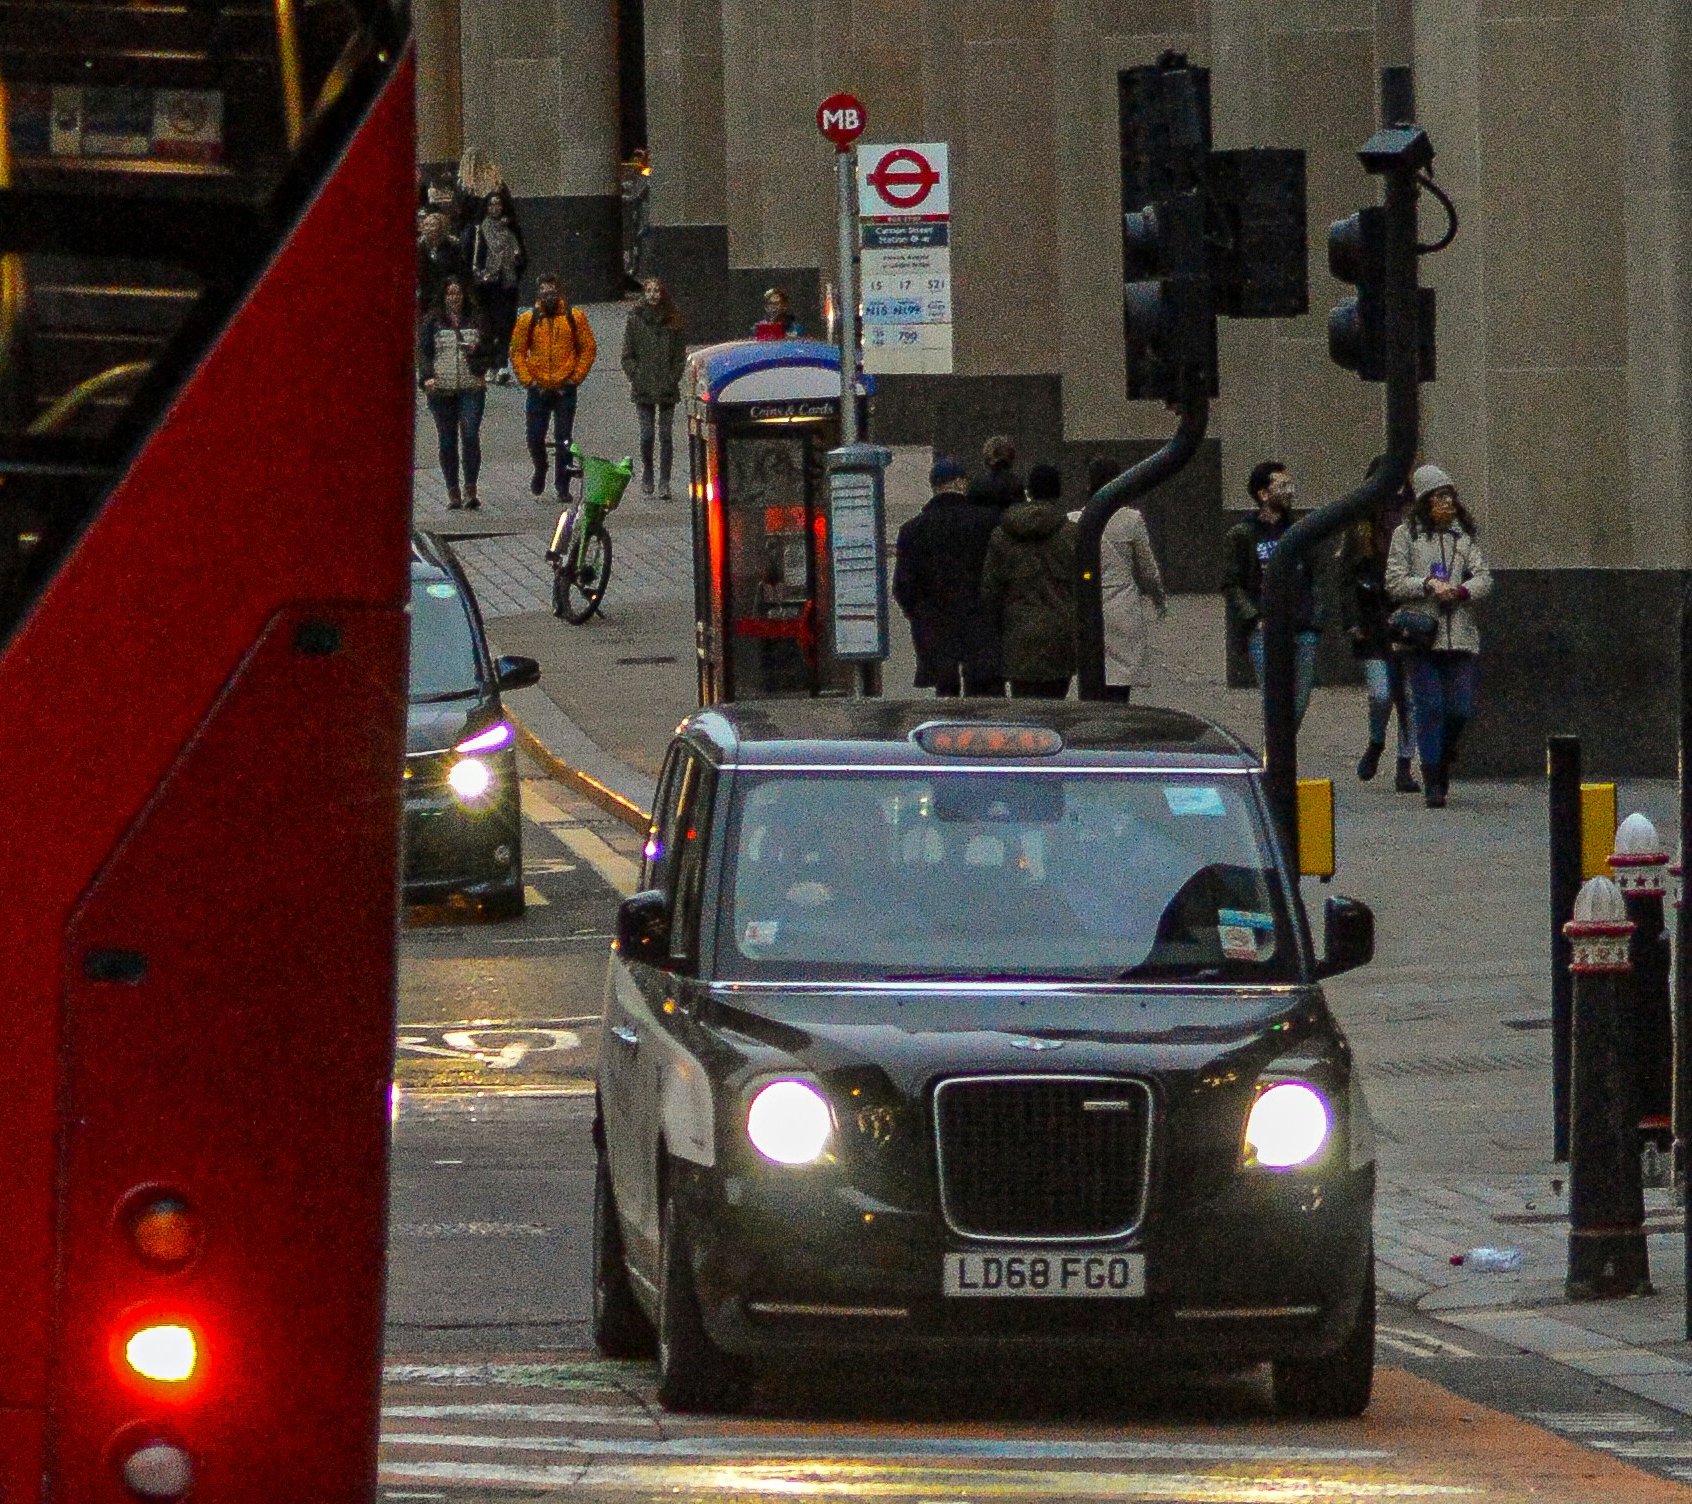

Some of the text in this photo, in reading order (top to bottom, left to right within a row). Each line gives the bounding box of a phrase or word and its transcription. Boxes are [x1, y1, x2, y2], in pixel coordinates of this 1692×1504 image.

[823, 109, 859, 129] MB
[871, 280, 882, 290] 15
[900, 280, 911, 290] 17
[928, 279, 945, 289] 521
[959, 1258, 1129, 1289] LD68 FGO
